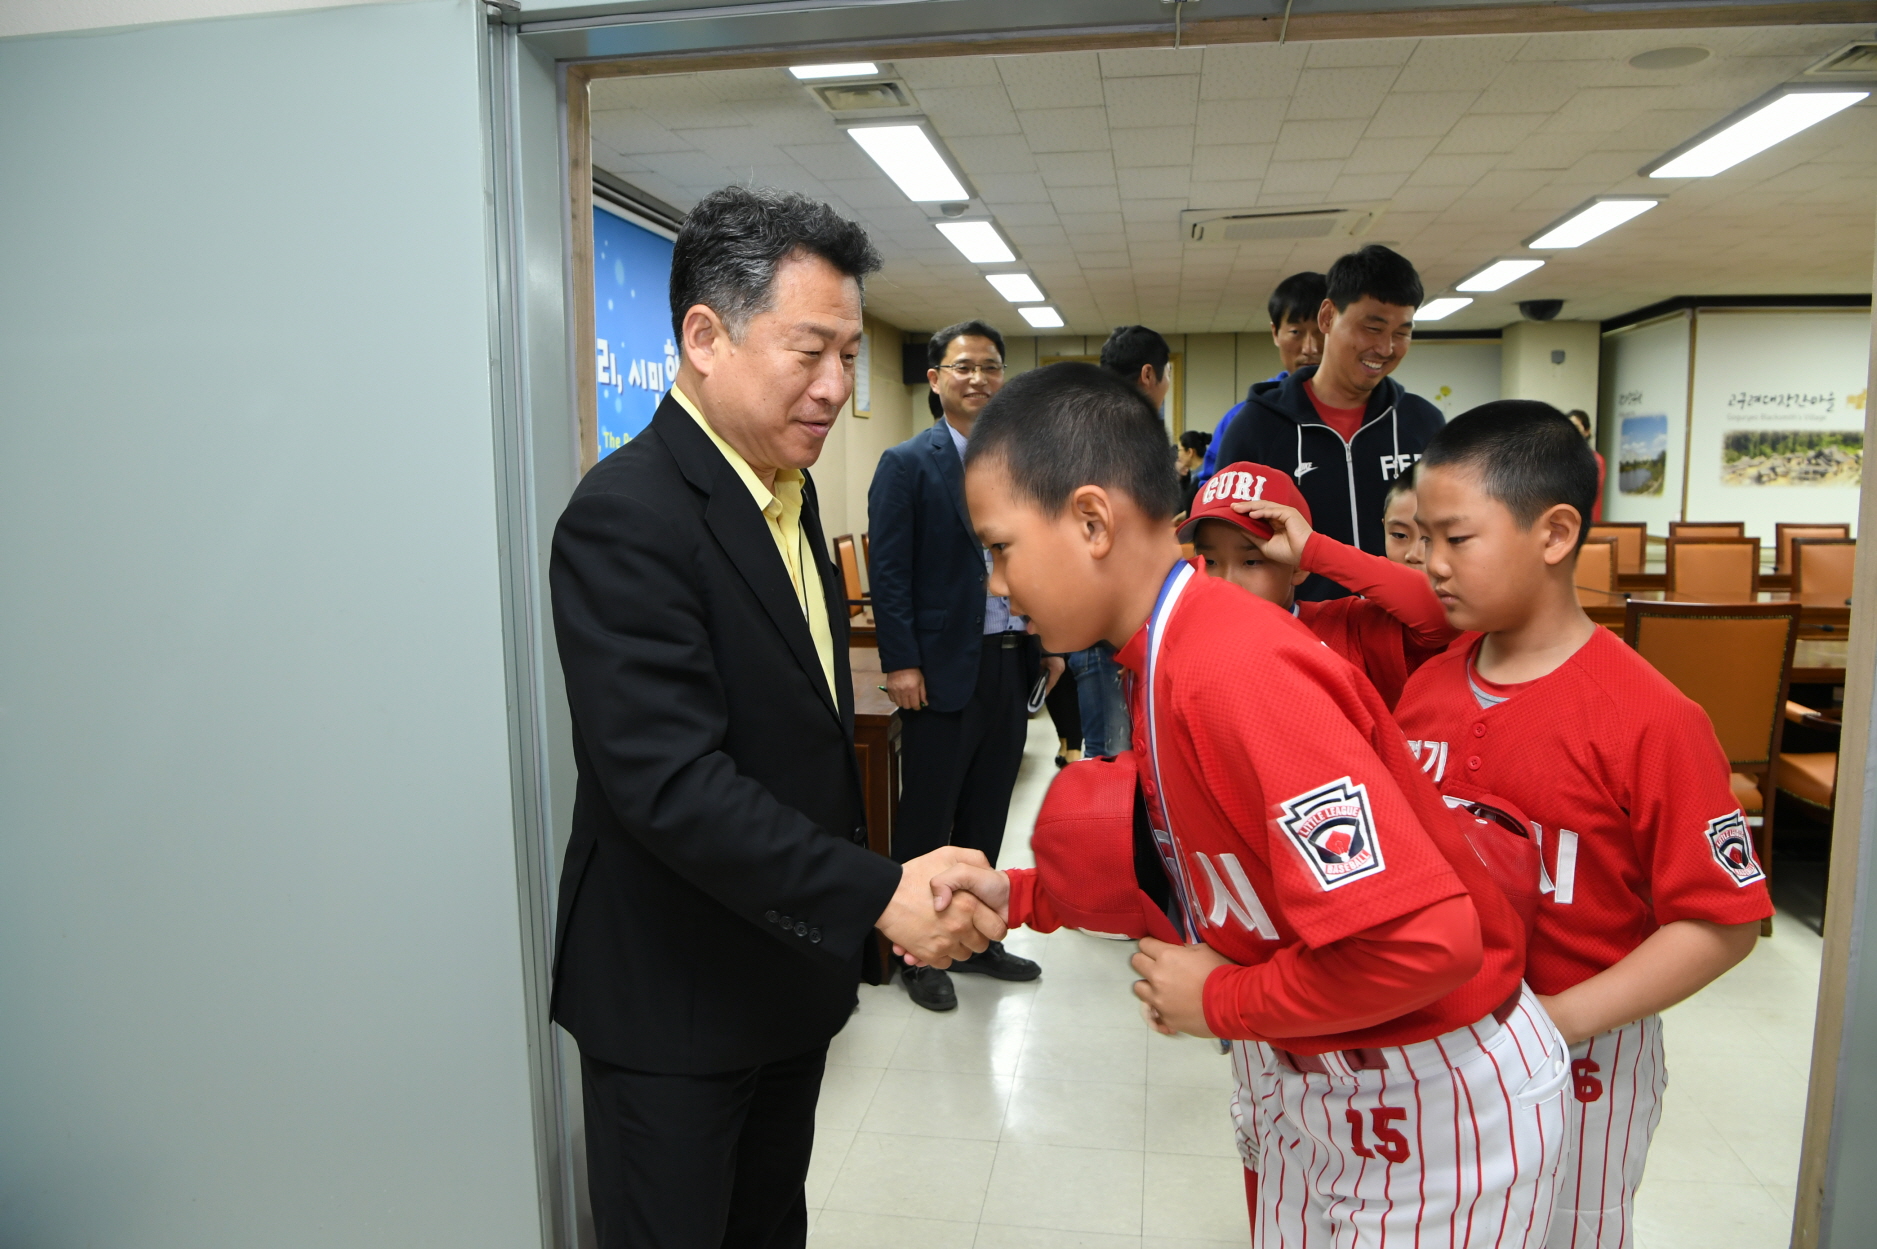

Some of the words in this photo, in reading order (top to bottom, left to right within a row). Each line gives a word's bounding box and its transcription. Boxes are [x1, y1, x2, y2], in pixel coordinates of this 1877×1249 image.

[1202, 471, 1267, 505] GURI
[1300, 811, 1326, 837] LITTLE
[1325, 806, 1360, 817] LEAGUE
[1327, 850, 1369, 873] BASEBALL
[1345, 1106, 1411, 1164] 15
